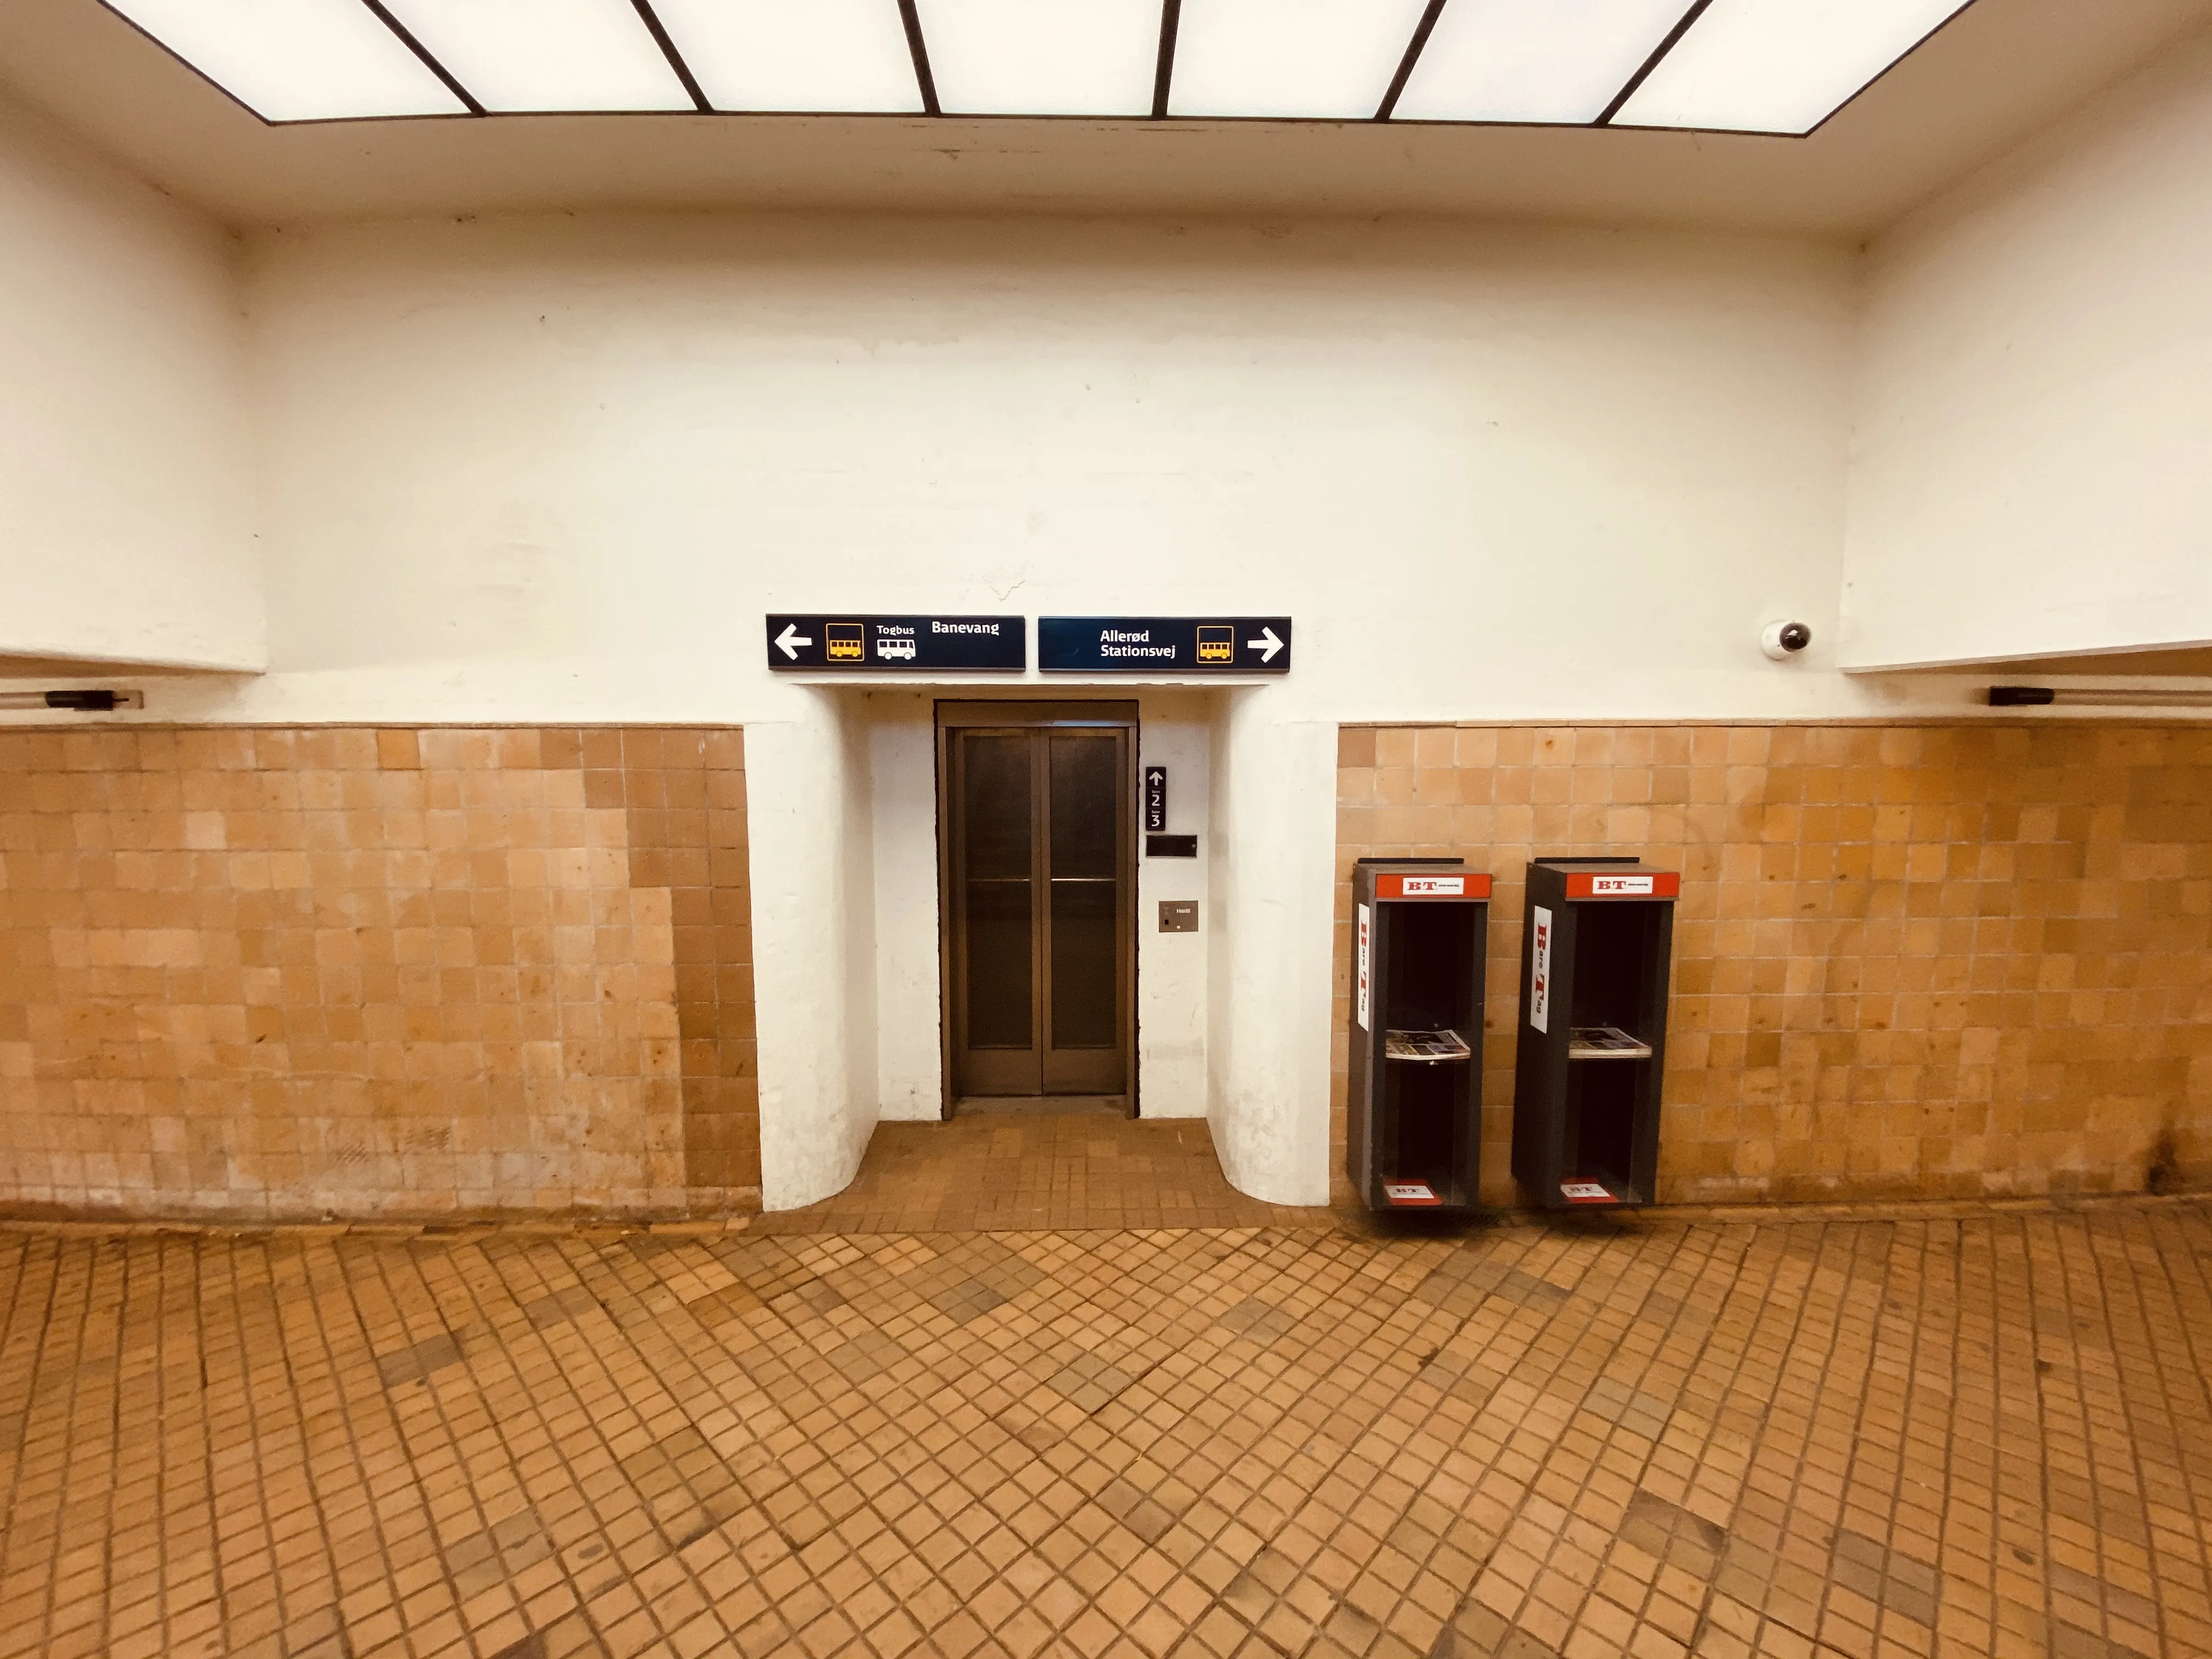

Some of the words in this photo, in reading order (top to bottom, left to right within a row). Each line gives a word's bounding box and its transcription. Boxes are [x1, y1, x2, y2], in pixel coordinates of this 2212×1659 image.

[876, 625, 915, 636] Togbus
[932, 621, 1000, 636] Banevang
[1100, 630, 1149, 642] Allerød
[1101, 645, 1176, 659] Stationsvej
[1152, 794, 1160, 806] 2
[1152, 815, 1160, 827] 3
[1537, 922, 1547, 969] Bare
[1535, 973, 1545, 1014] Tag
